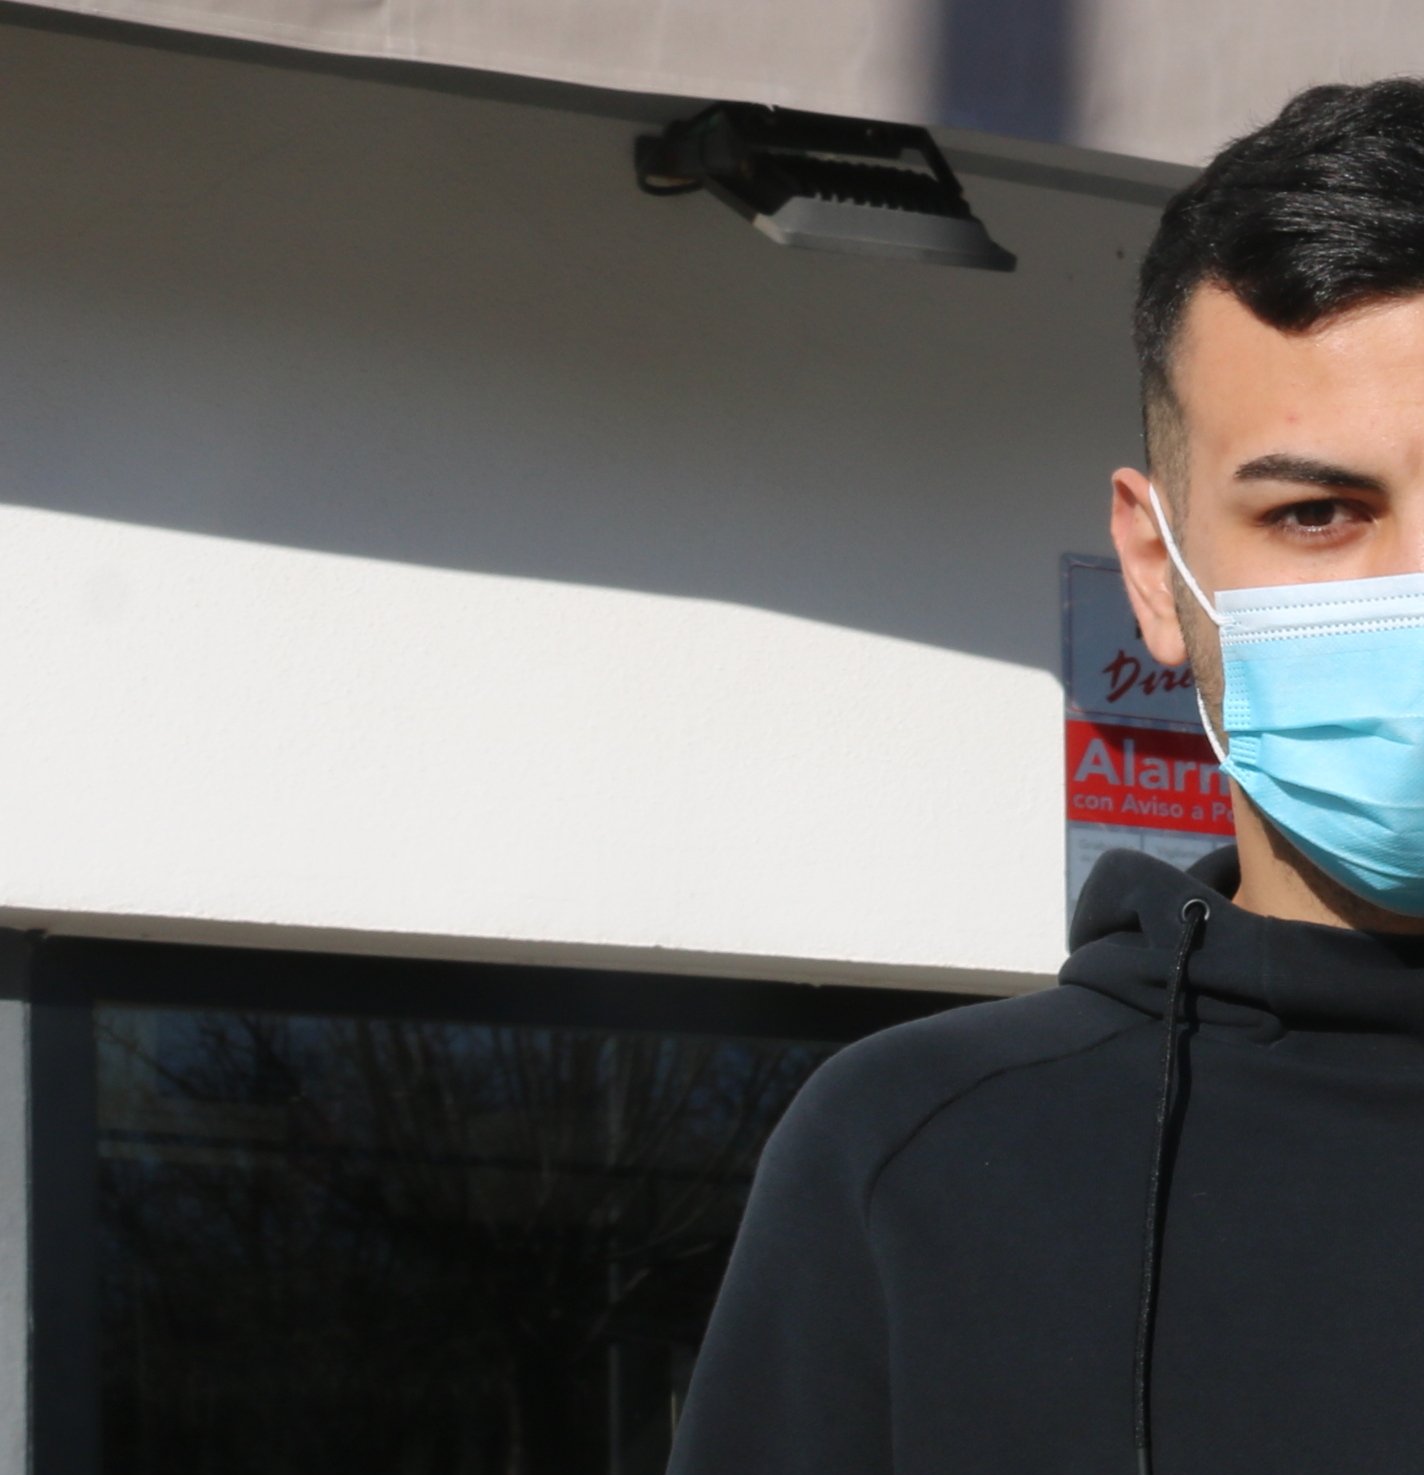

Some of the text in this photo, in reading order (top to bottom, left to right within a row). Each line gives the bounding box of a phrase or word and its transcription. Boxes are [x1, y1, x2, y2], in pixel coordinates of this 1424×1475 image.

[1072, 793, 1113, 811] con
[1121, 794, 1184, 818] Aviso
[1191, 804, 1205, 820] a
